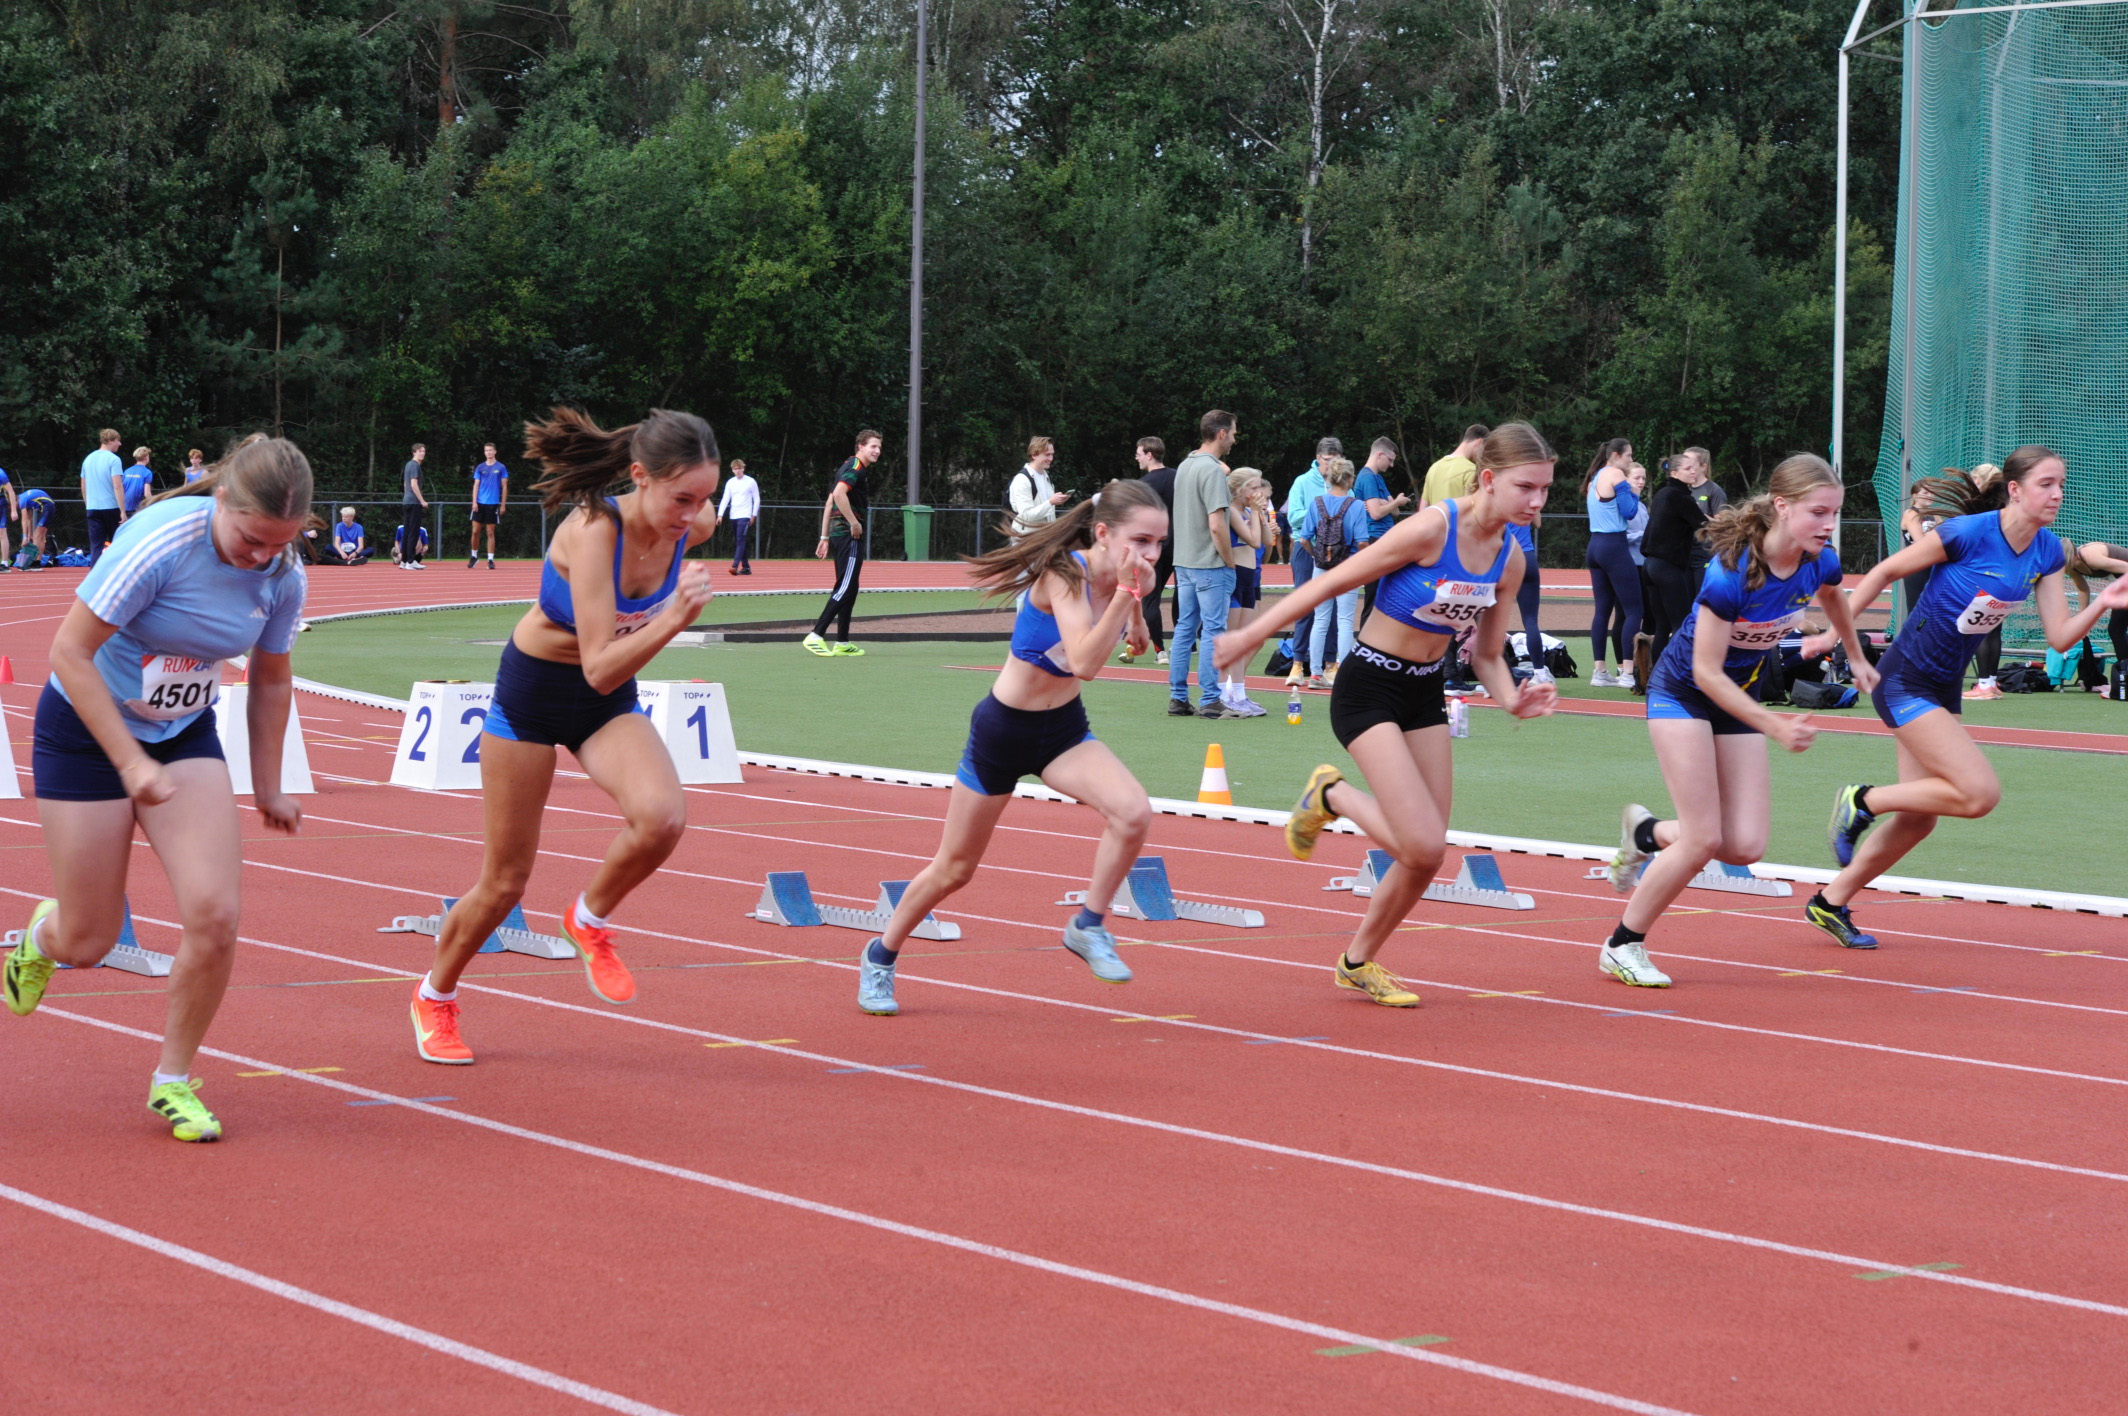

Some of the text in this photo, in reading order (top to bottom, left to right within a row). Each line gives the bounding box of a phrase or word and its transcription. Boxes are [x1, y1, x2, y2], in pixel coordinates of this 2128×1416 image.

[1967, 610, 2005, 626] 355
[1355, 646, 1402, 671] PRO
[148, 680, 213, 709] 4501
[409, 705, 432, 762] 2
[460, 707, 488, 763] 2
[687, 705, 709, 759] 1
